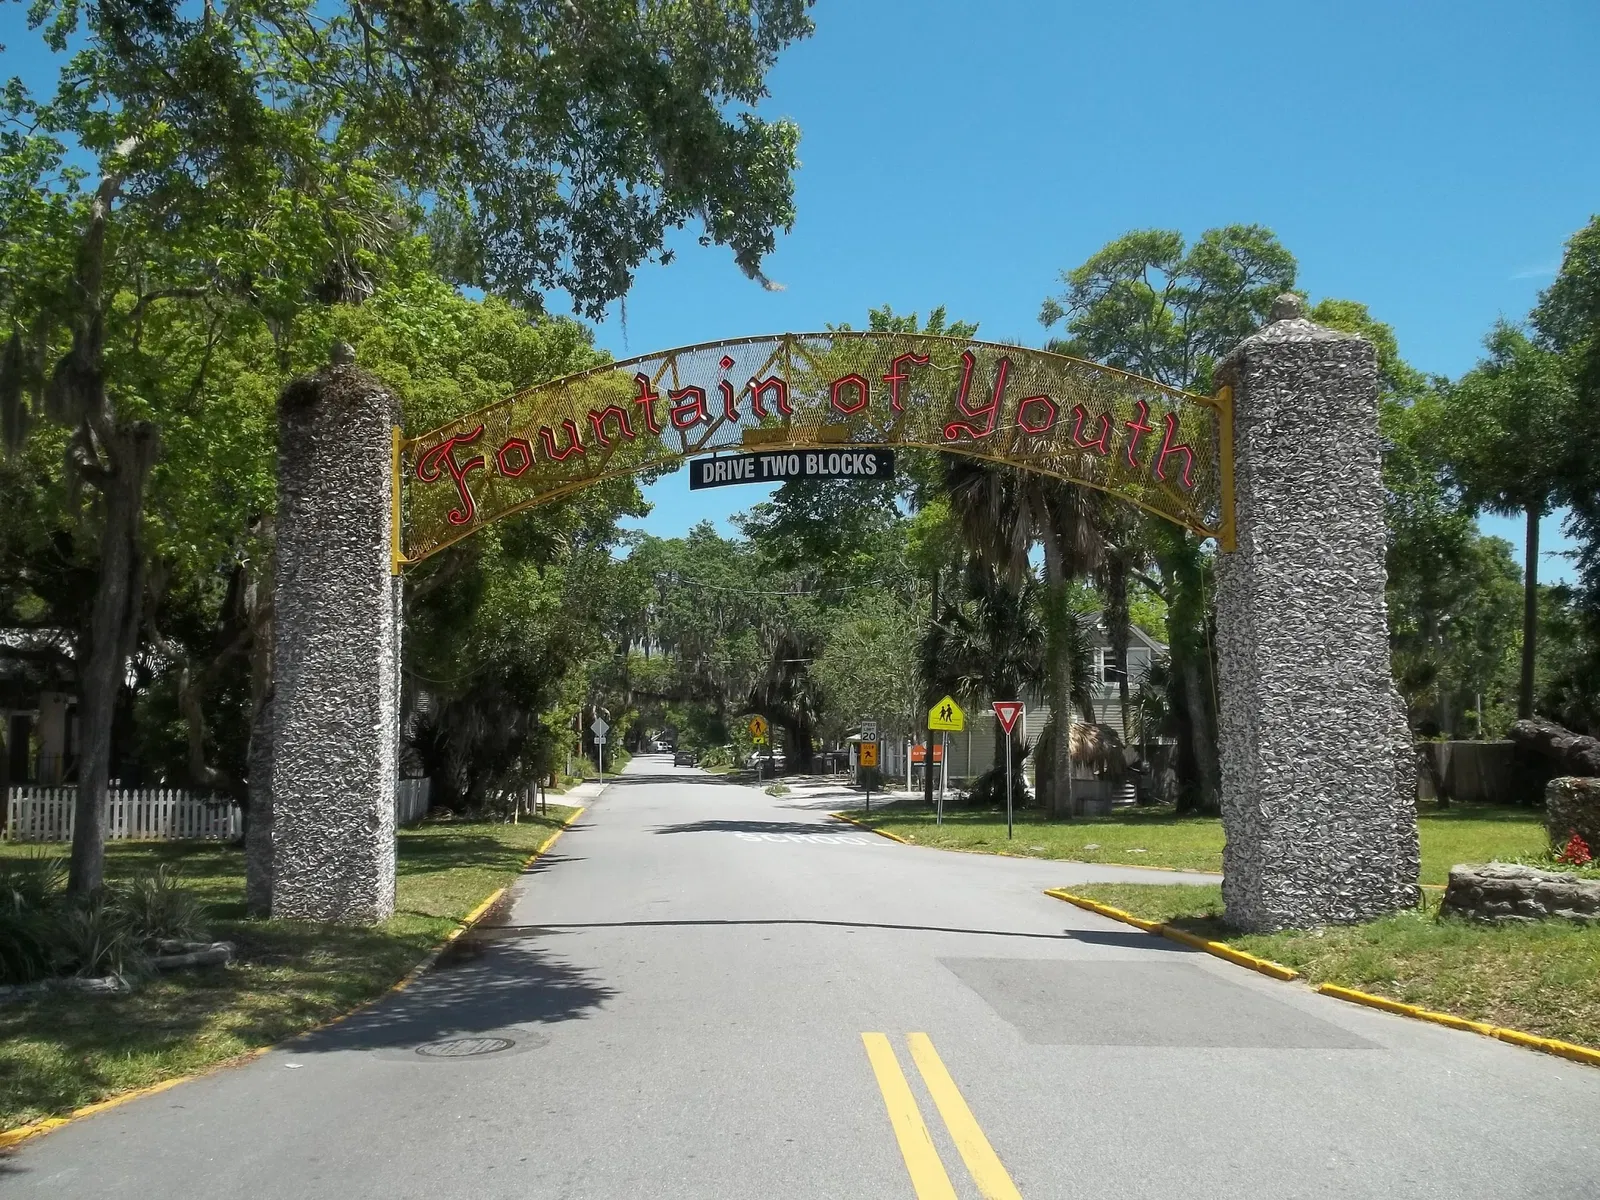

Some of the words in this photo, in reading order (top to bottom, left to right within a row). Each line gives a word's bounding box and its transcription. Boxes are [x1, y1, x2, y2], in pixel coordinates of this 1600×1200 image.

[416, 354, 794, 526] Fountain
[829, 350, 931, 417] of
[943, 348, 1197, 492] Youth
[702, 457, 755, 484] DRIVE
[760, 454, 800, 477] TWO
[806, 453, 877, 475] BLOCKS
[862, 732, 876, 741] 20
[735, 832, 896, 847] SCHOOL
